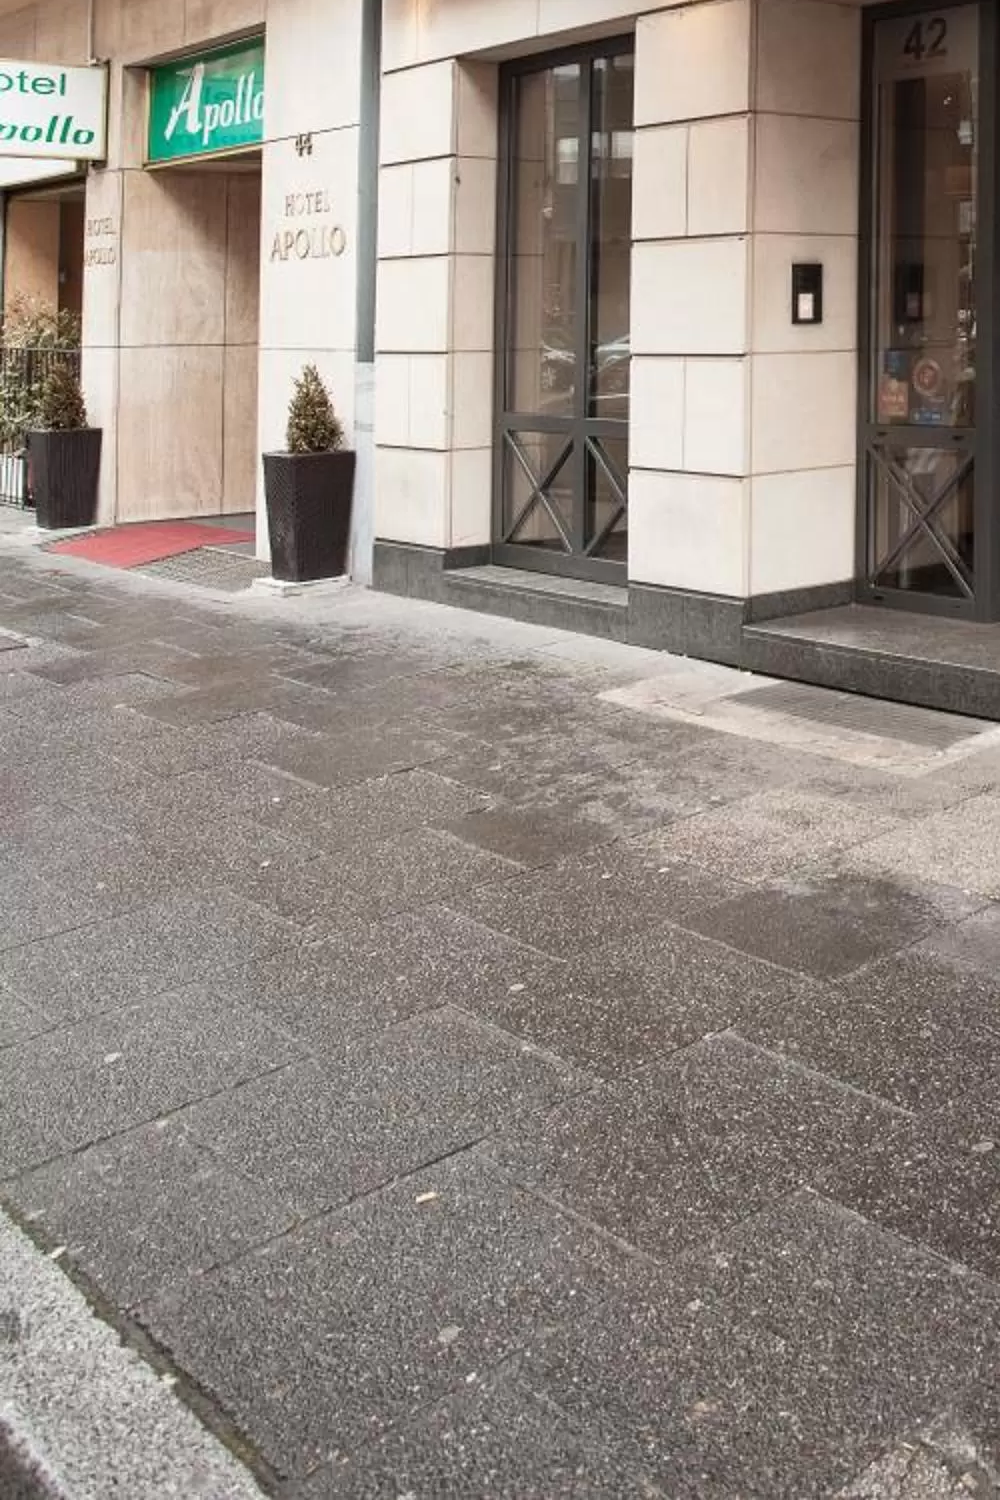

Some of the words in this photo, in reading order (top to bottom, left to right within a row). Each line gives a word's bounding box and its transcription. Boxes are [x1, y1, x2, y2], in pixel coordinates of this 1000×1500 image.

[904, 17, 948, 60] 42
[295, 133, 313, 157] 44
[285, 190, 331, 216] HOTEL
[270, 224, 347, 263] APOLLO
